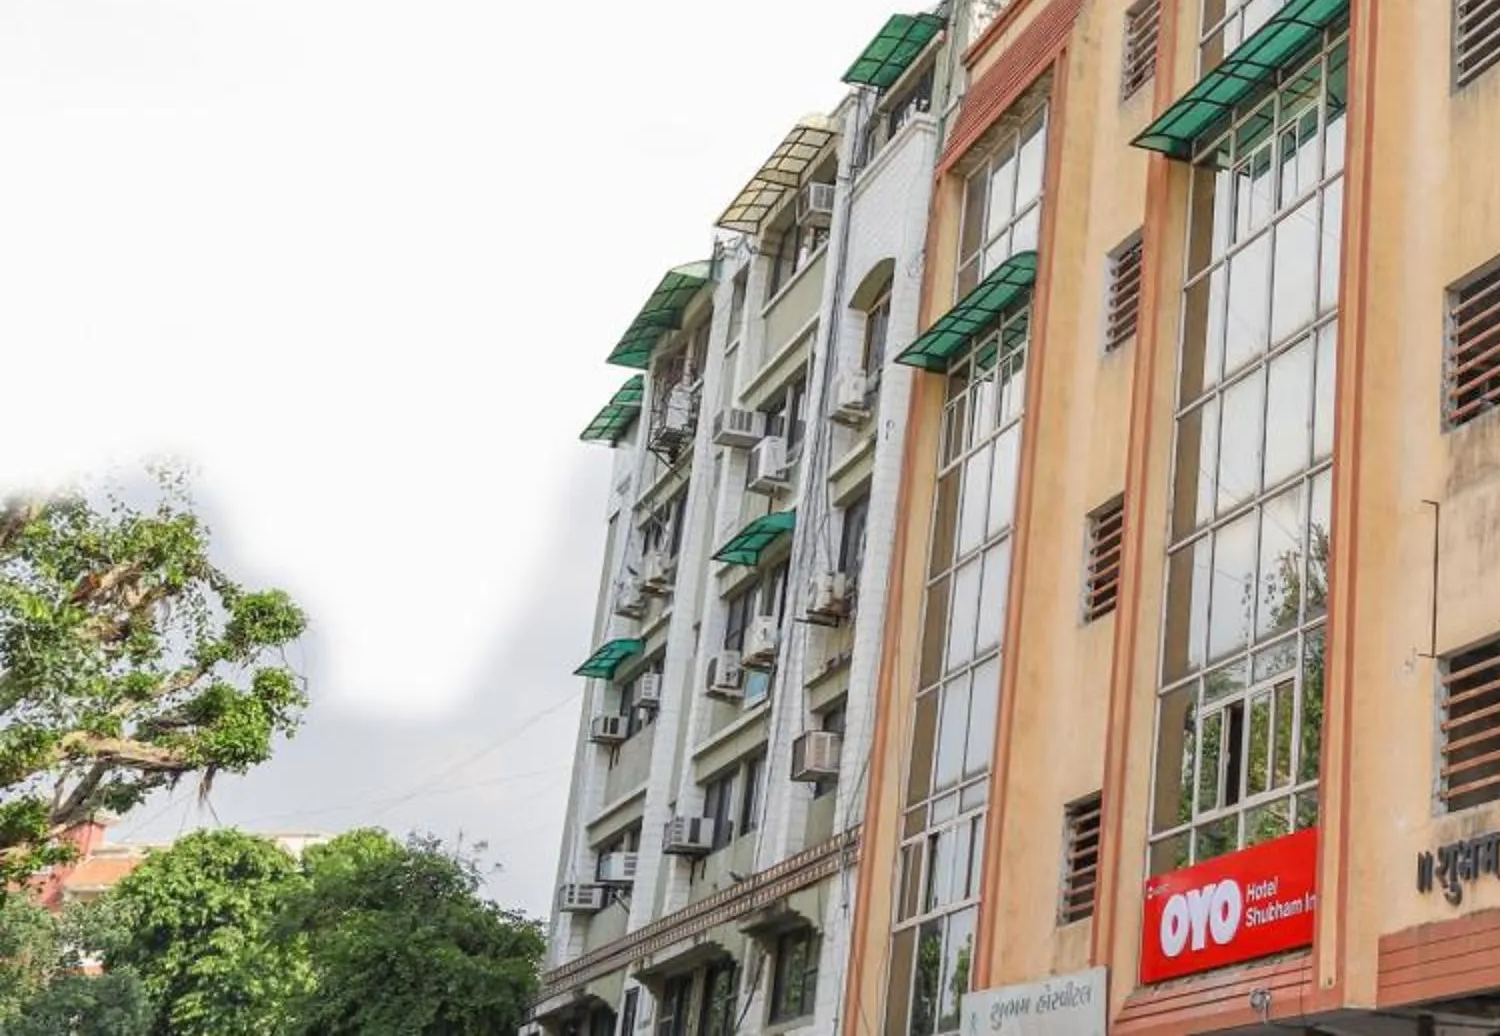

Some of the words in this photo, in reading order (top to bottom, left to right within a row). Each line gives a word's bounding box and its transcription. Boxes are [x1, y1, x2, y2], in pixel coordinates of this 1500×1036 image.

[1245, 875, 1279, 903] Hotel
[1160, 879, 1242, 957] OYO
[1245, 897, 1303, 928] Shubham
